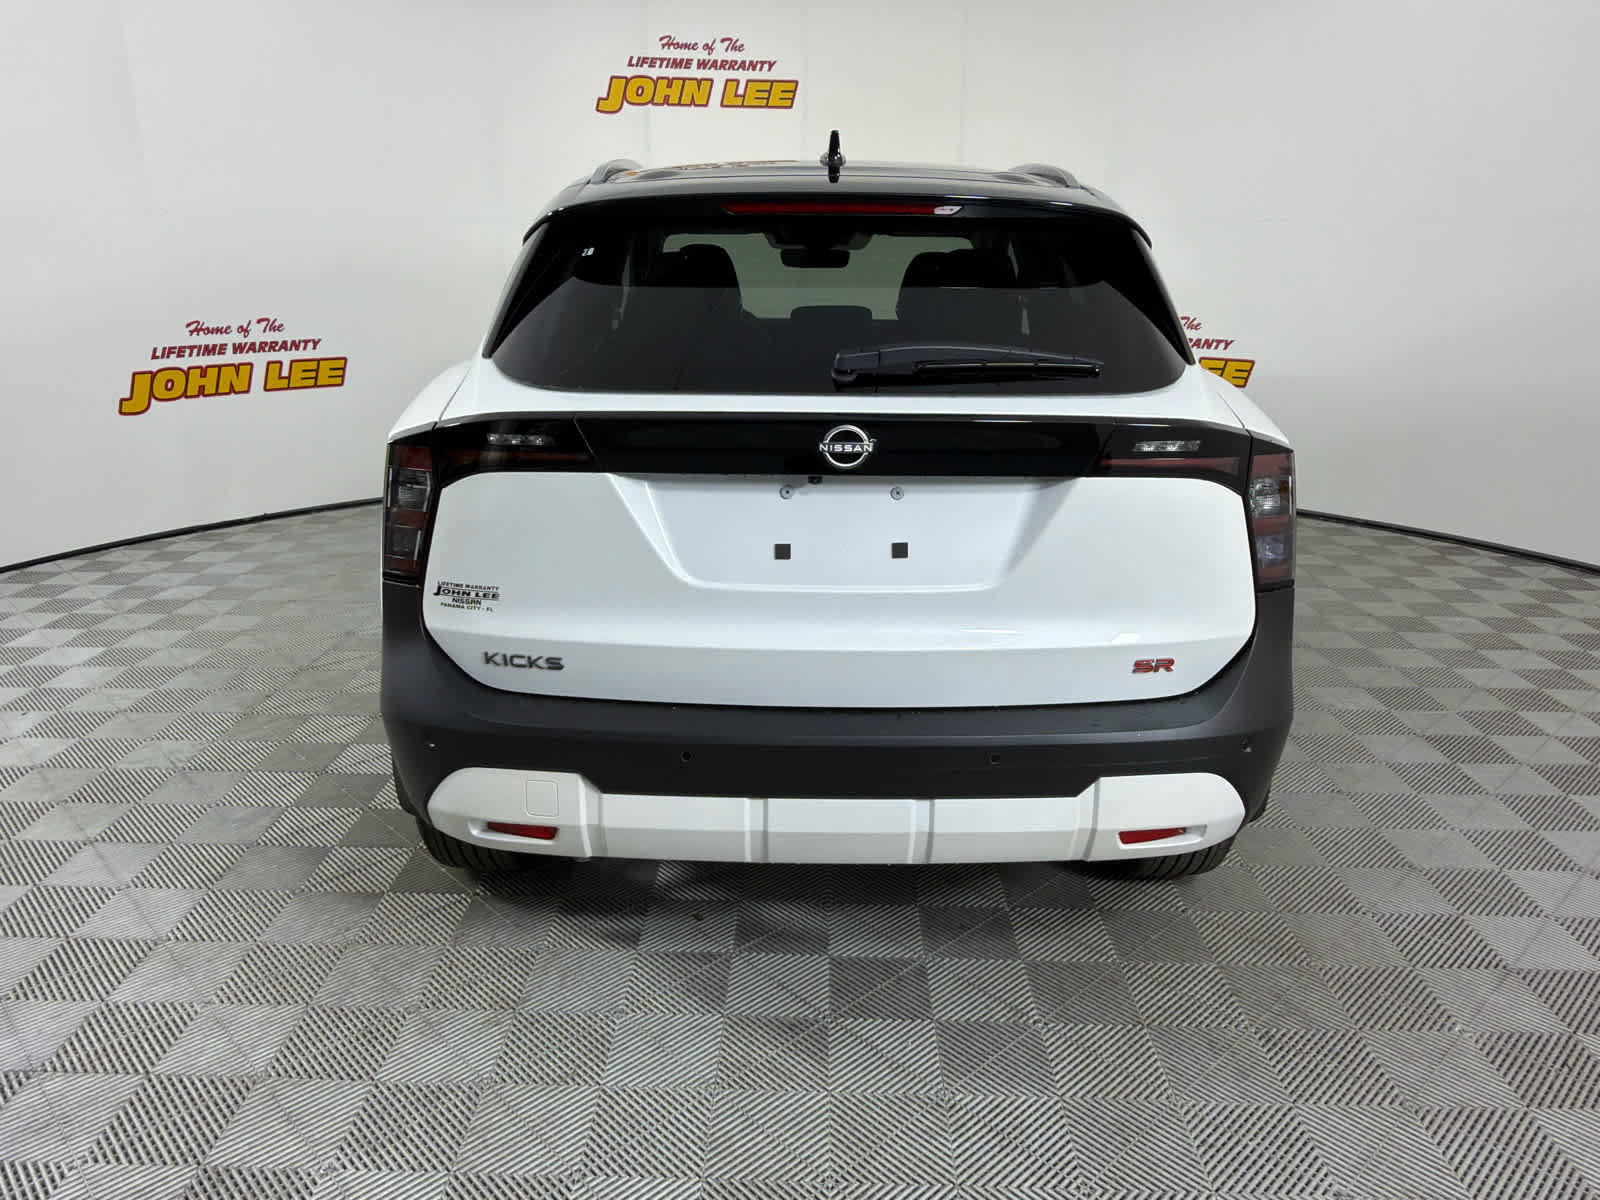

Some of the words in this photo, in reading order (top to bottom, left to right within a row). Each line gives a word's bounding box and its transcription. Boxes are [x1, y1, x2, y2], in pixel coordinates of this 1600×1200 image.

[658, 35, 699, 51] Home
[702, 38, 716, 55] of
[720, 37, 745, 53] The
[627, 56, 693, 70] LIFETIME
[696, 58, 777, 72] WARRANTY
[596, 75, 714, 114] JOHN
[720, 78, 799, 109] LEE
[185, 320, 232, 337] Home
[236, 320, 252, 337] of
[256, 317, 285, 333] The
[1180, 316, 1202, 330] The
[151, 343, 228, 360] LIFETIME
[232, 338, 321, 355] WARRANTY
[119, 362, 254, 416] JOHN
[263, 357, 348, 392] LEE
[819, 443, 873, 452] NISSAN
[433, 585, 471, 597] JOHN
[474, 590, 500, 600] LEE
[465, 583, 499, 591] WARRANTY
[440, 602, 465, 610] PANAMA
[452, 597, 482, 606] NISSAN
[483, 651, 565, 671] KICKS
[1132, 658, 1175, 674] SR
